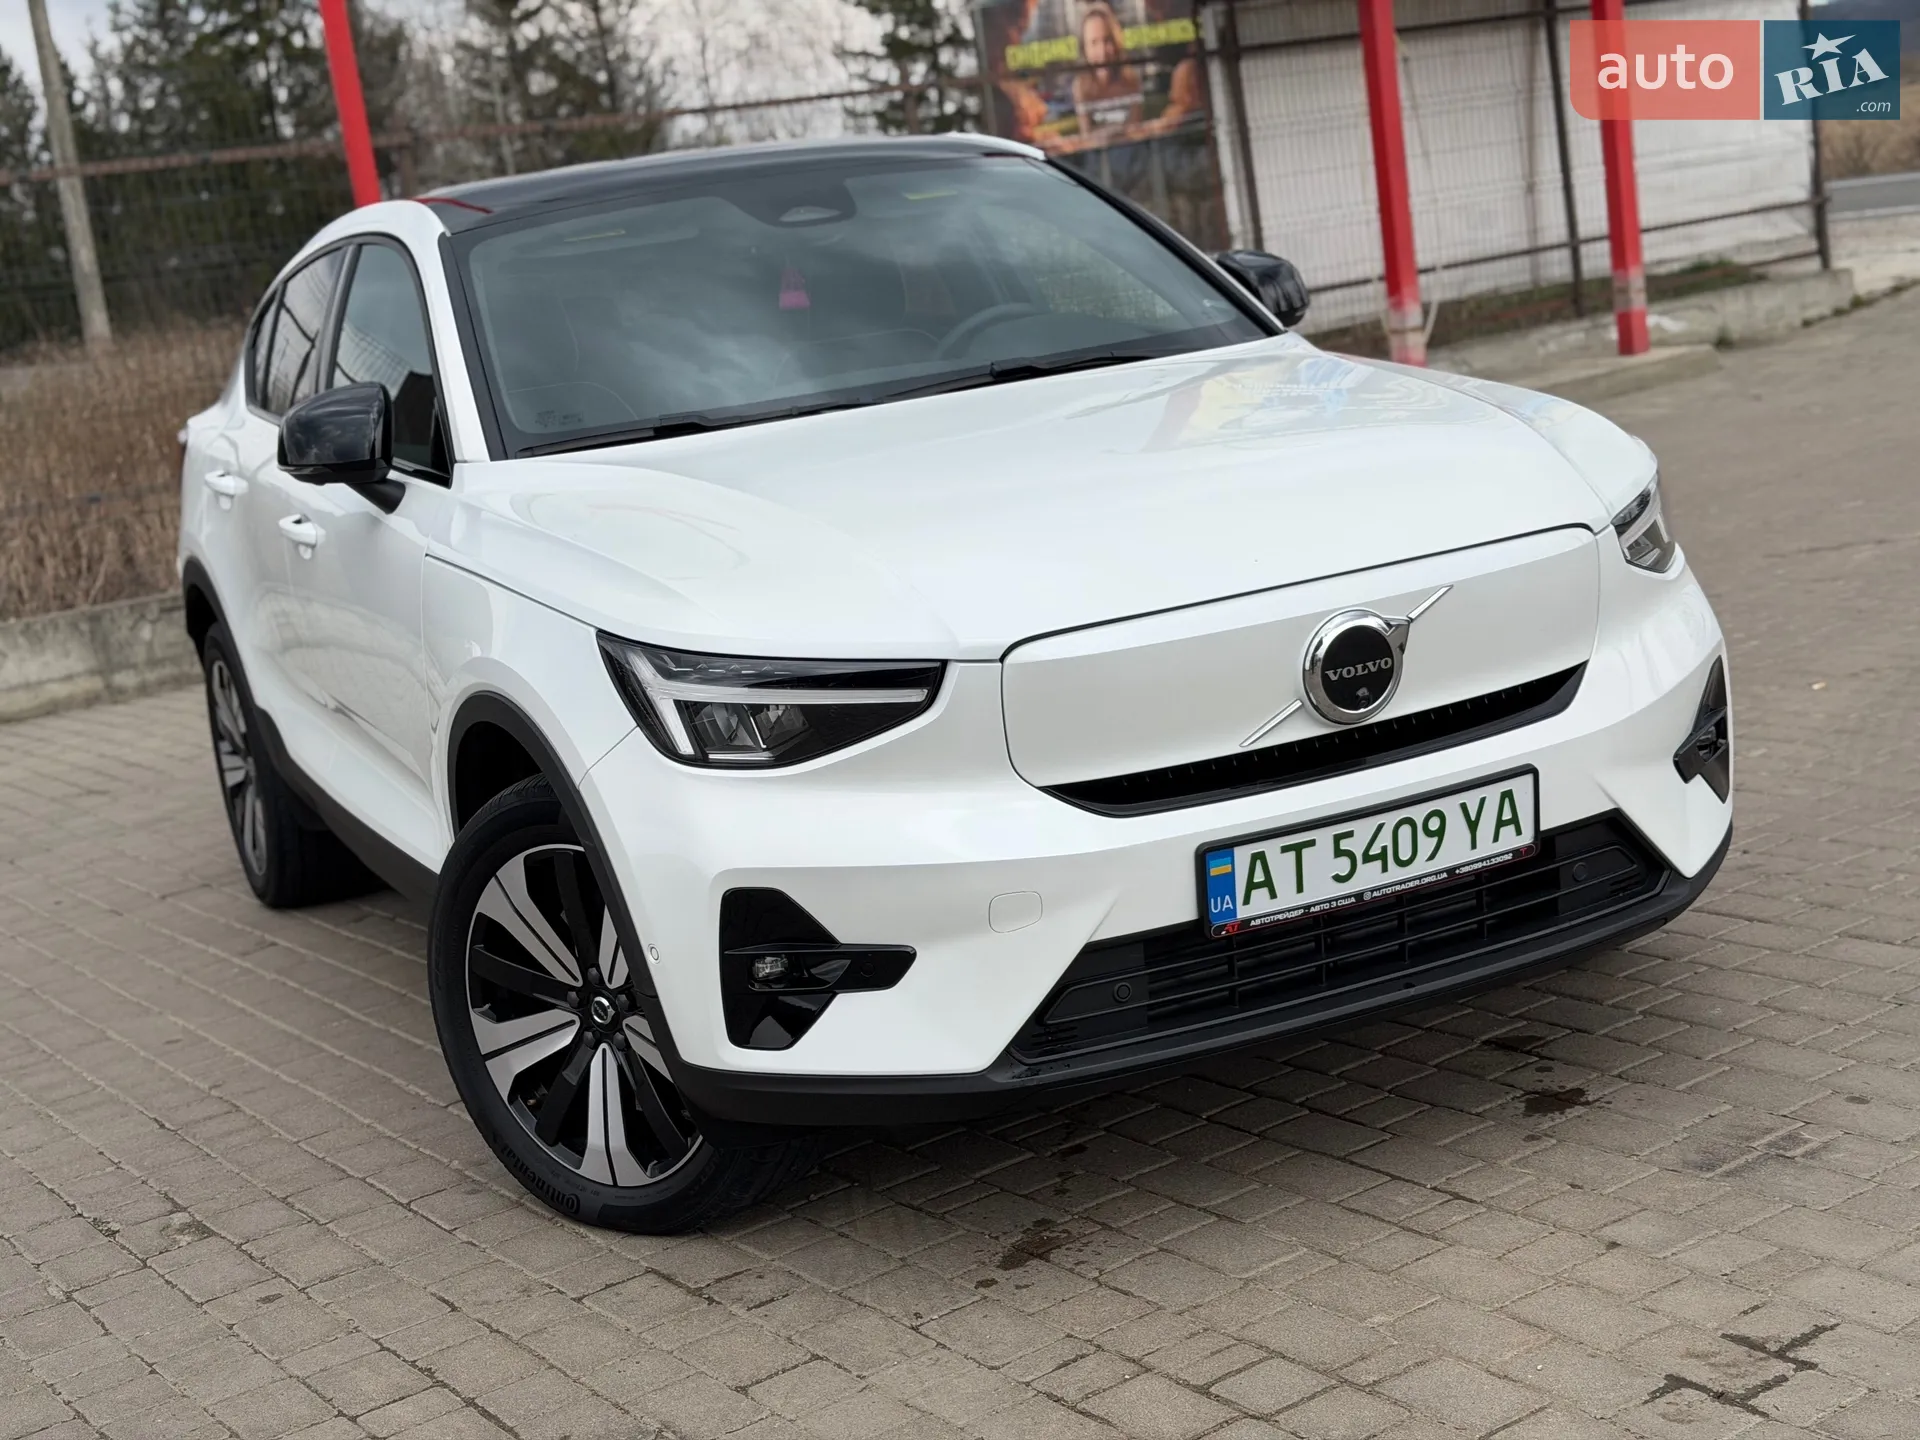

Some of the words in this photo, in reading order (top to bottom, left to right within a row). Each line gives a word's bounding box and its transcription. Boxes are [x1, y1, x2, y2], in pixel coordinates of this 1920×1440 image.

[1325, 657, 1392, 681] VOLVO
[1241, 838, 1317, 907] AT
[1330, 808, 1447, 884] 5409
[1459, 787, 1523, 852] YA
[1210, 894, 1234, 915] UA
[1249, 908, 1305, 927] АВТОТРЕЙДЕР
[1337, 896, 1356, 907] США
